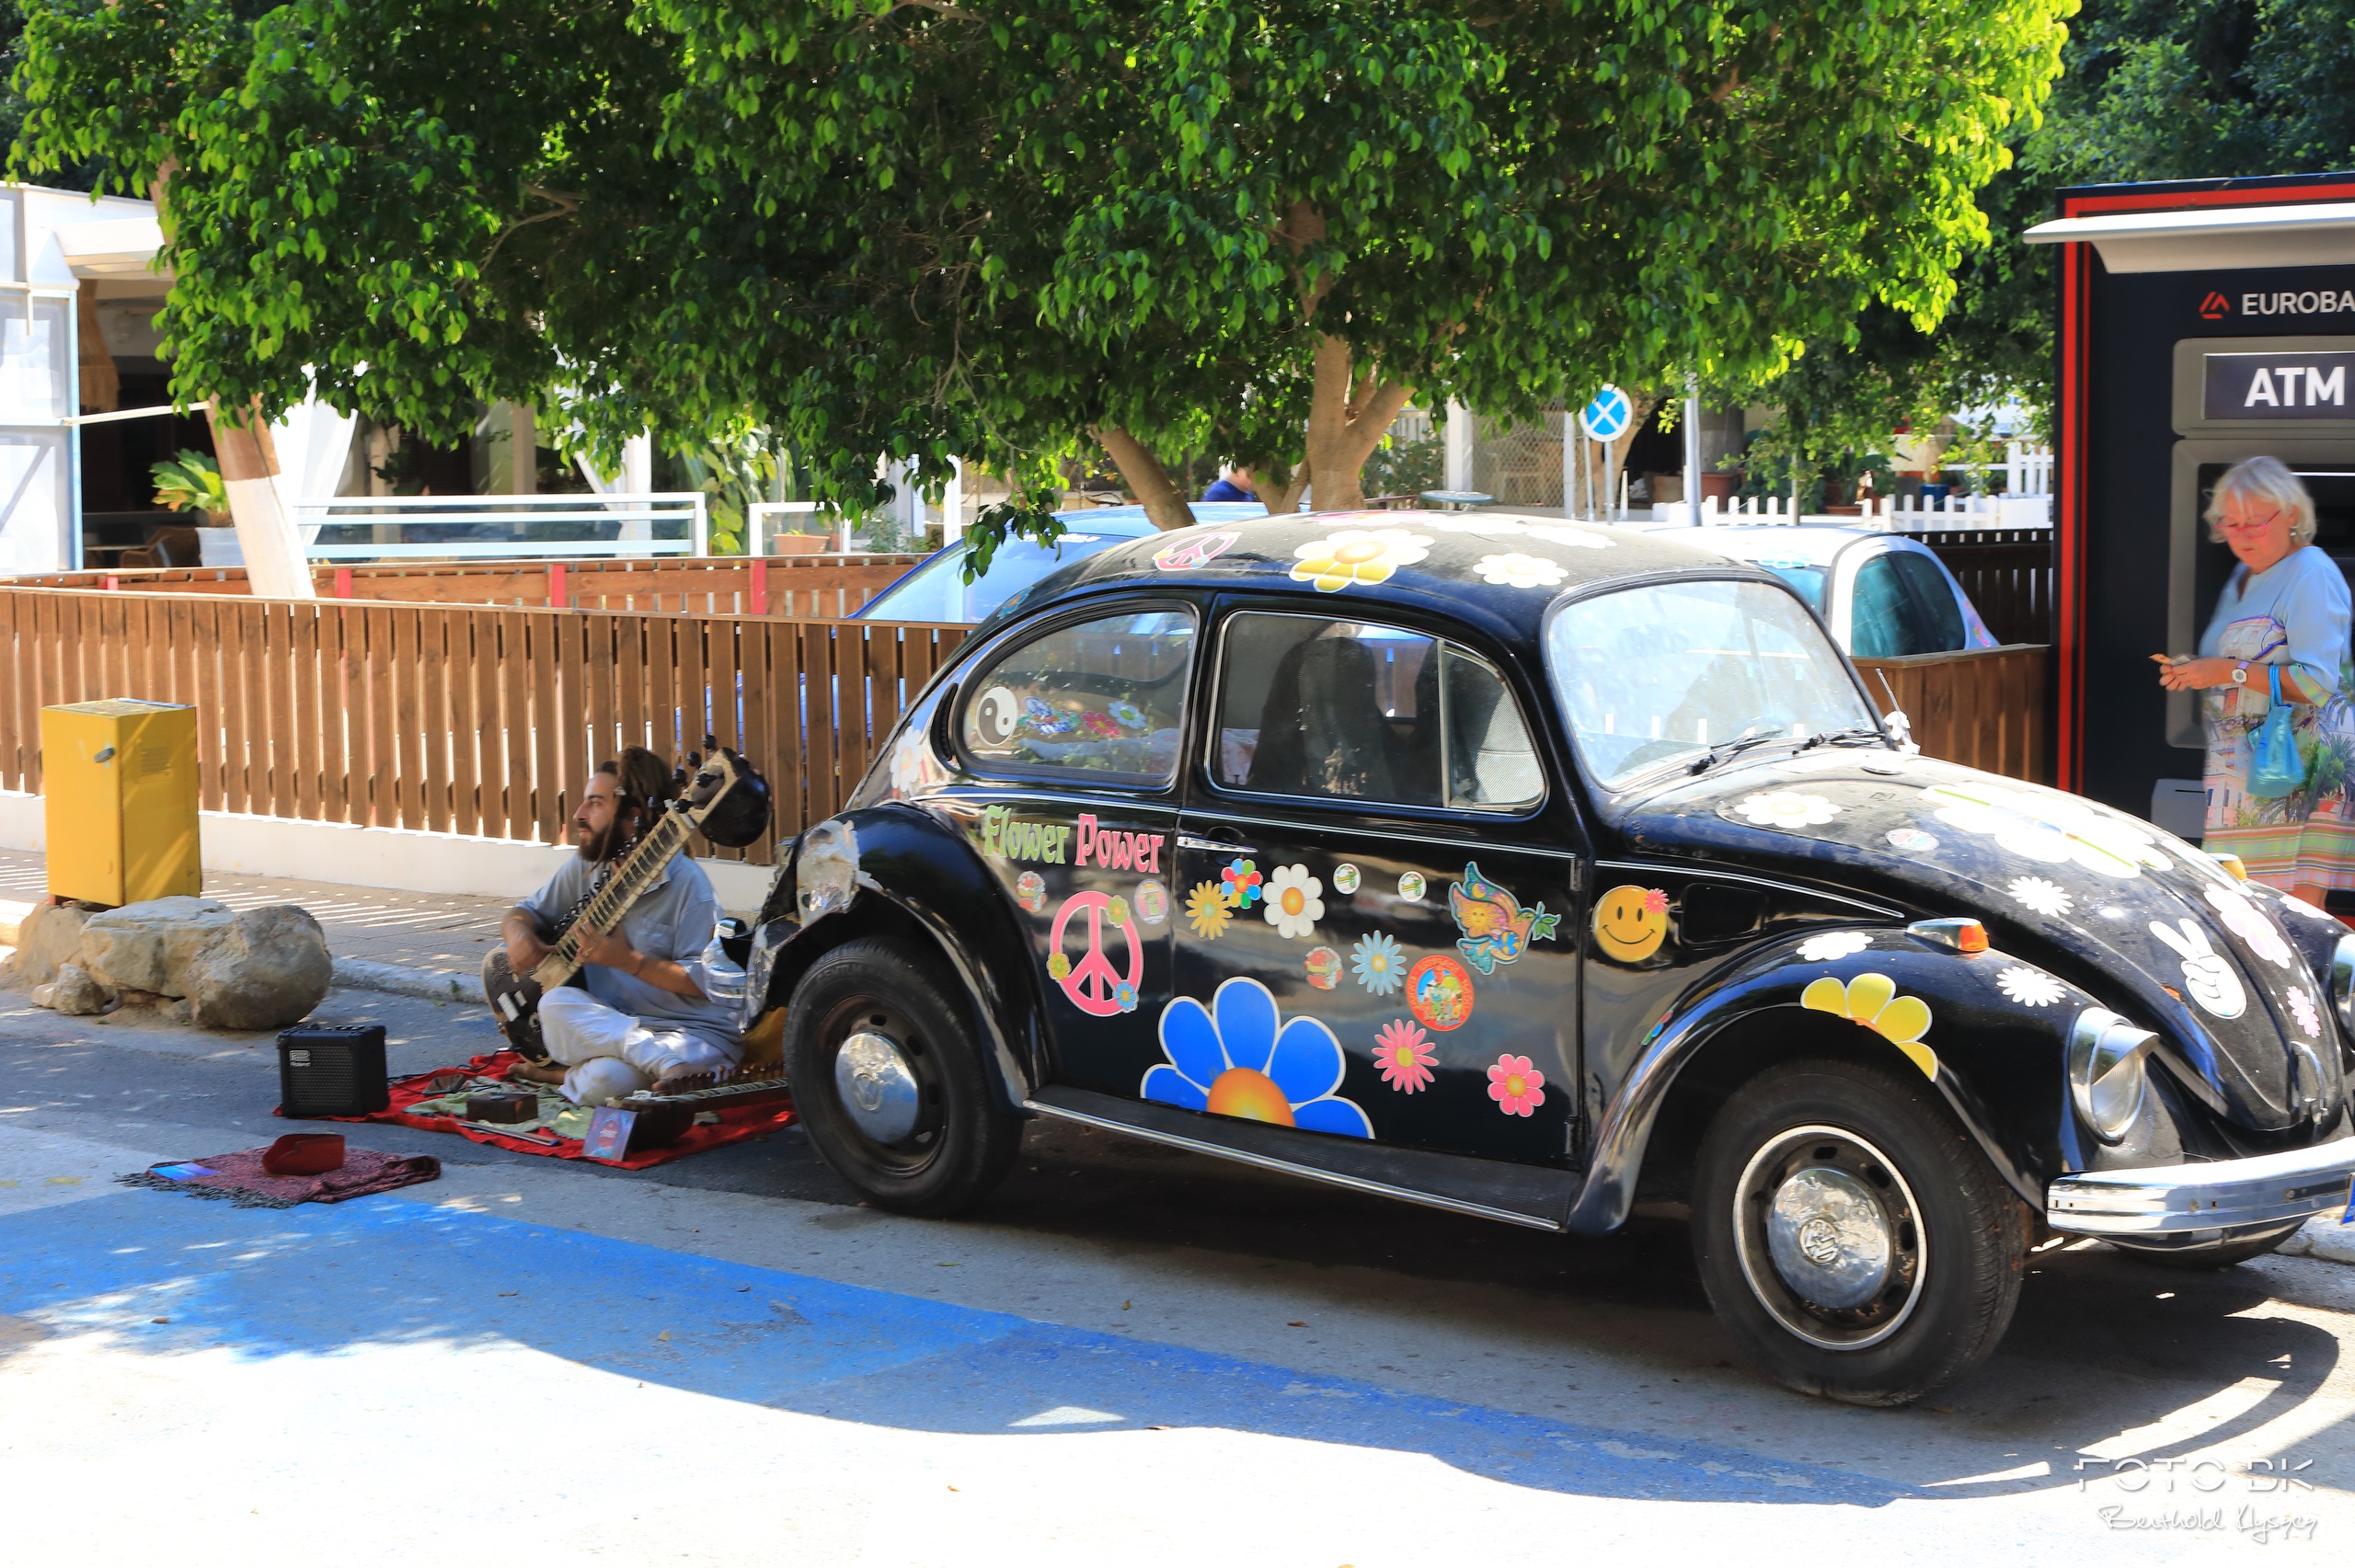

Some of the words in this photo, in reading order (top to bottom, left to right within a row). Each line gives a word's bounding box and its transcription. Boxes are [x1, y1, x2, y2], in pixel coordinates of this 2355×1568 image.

[2242, 291, 2355, 315] EUROBA
[2245, 366, 2345, 407] ATM
[983, 805, 1070, 864] Flower
[1074, 813, 1165, 873] Power
